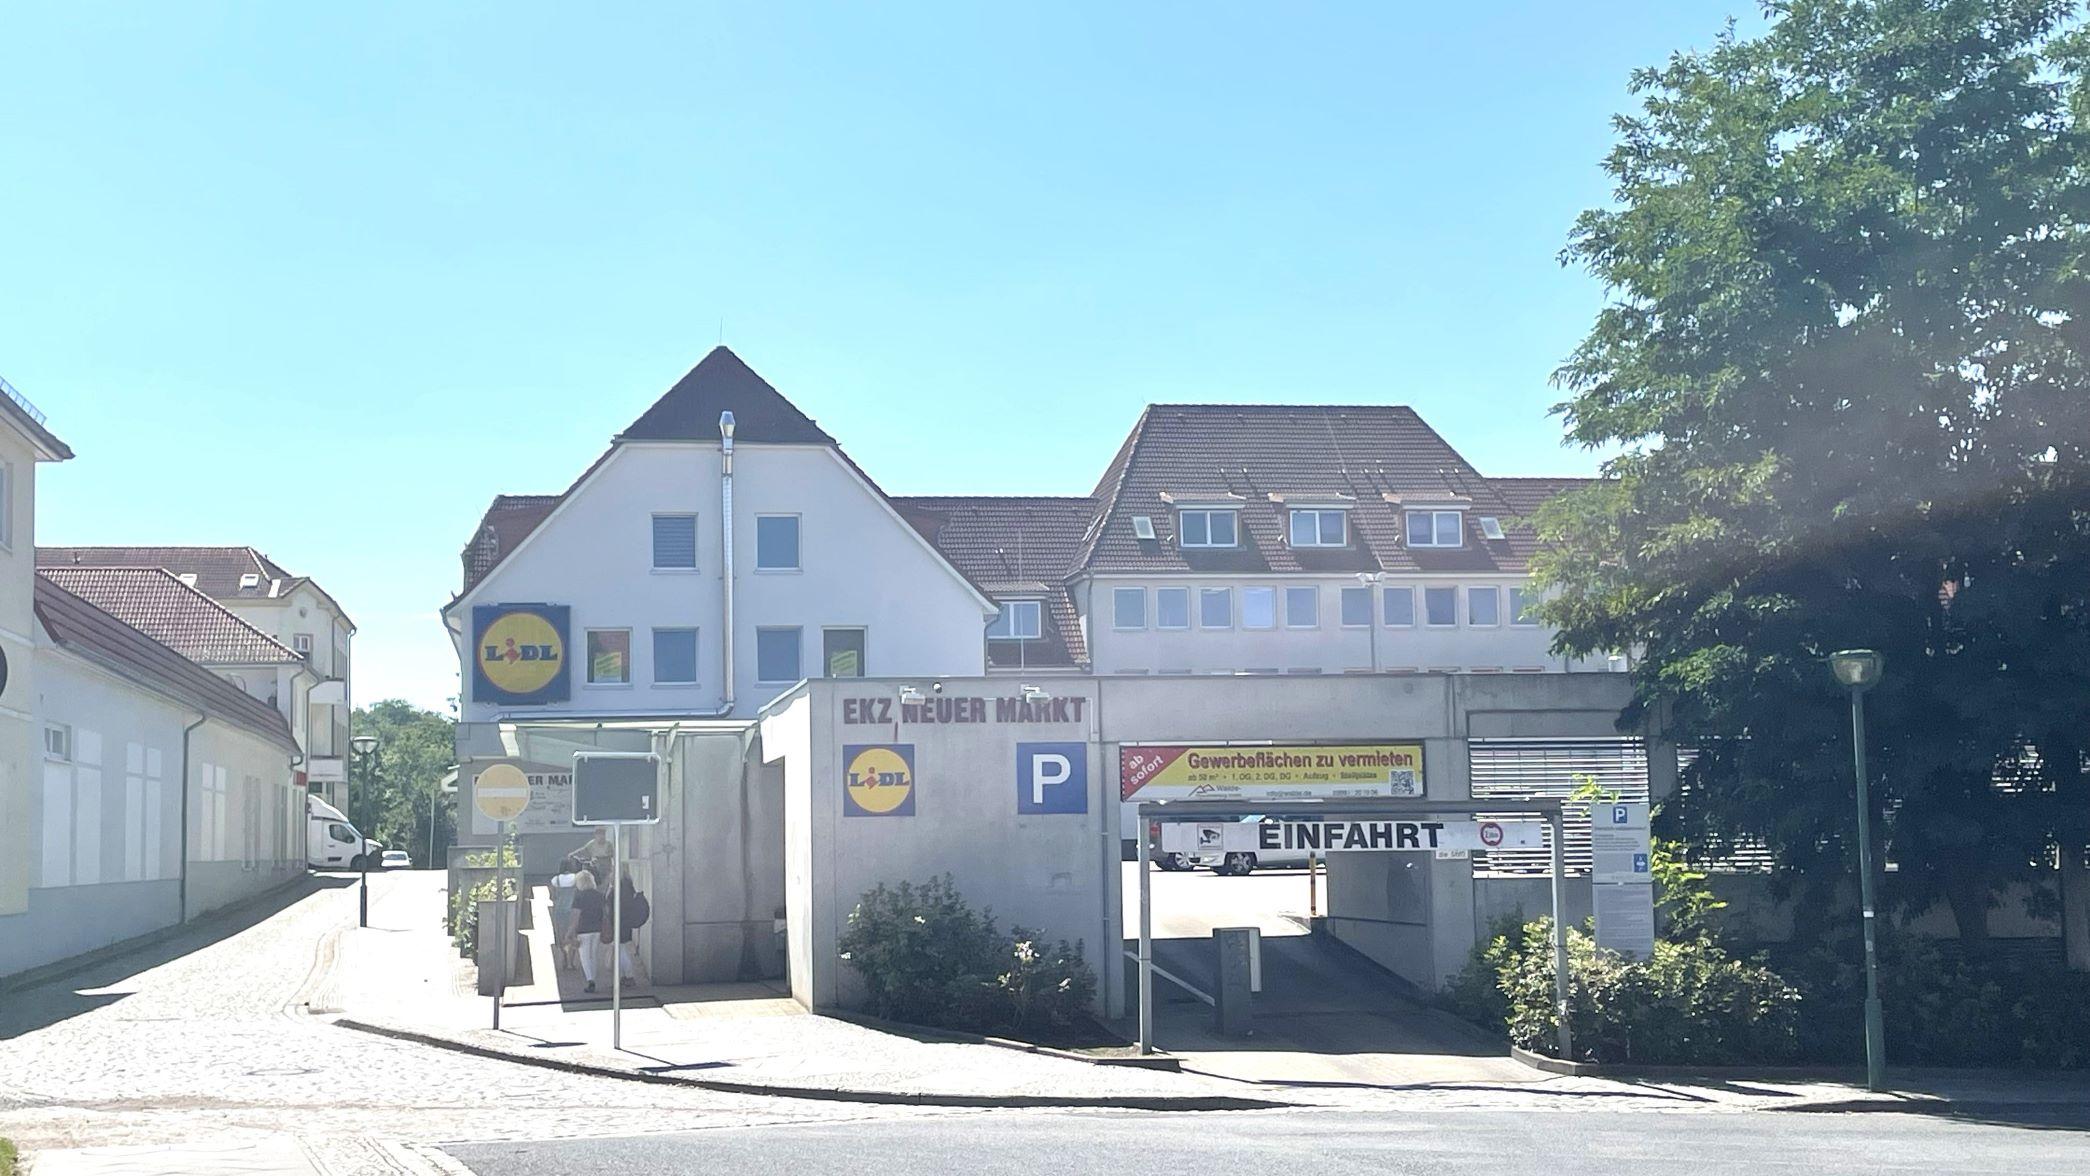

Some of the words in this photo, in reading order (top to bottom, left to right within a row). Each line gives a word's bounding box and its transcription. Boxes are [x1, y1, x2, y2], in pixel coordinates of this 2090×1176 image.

[843, 698, 893, 724] EKZ
[902, 697, 986, 723] NEUER
[996, 696, 1086, 723] MARKT
[1128, 754, 1144, 770] ab
[1130, 754, 1164, 785] sofort
[1187, 752, 1312, 769] Gewerbeflächen
[1316, 754, 1334, 768] zu
[1338, 750, 1413, 767] vermieten
[1032, 753, 1072, 804] P
[1615, 808, 1626, 822] P
[1259, 823, 1444, 849] EINFAHRT
